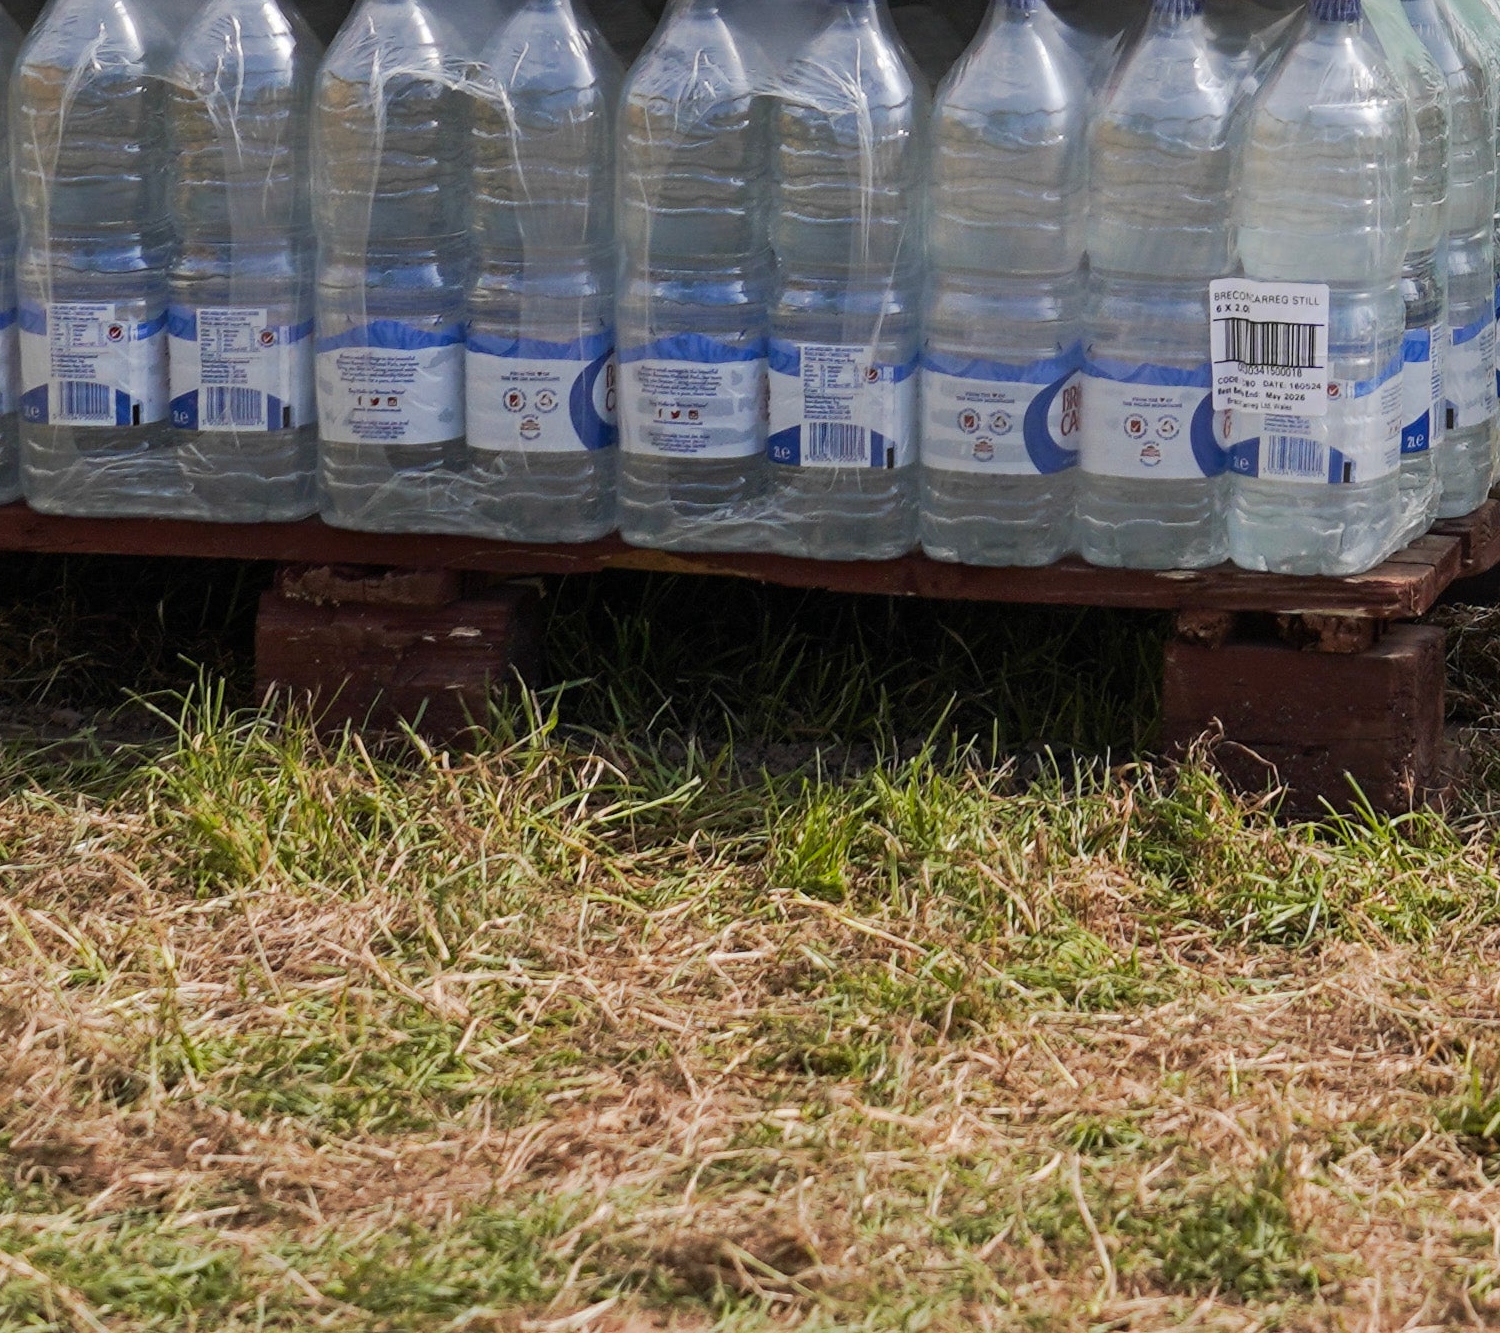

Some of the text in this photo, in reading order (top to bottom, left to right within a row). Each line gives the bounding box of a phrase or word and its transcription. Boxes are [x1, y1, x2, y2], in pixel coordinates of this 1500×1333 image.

[1292, 295, 1320, 306] STILL
[1216, 304, 1222, 313] 6
[1225, 304, 1231, 312] X
[1266, 391, 1280, 400] May
[1284, 393, 1306, 401] 2026
